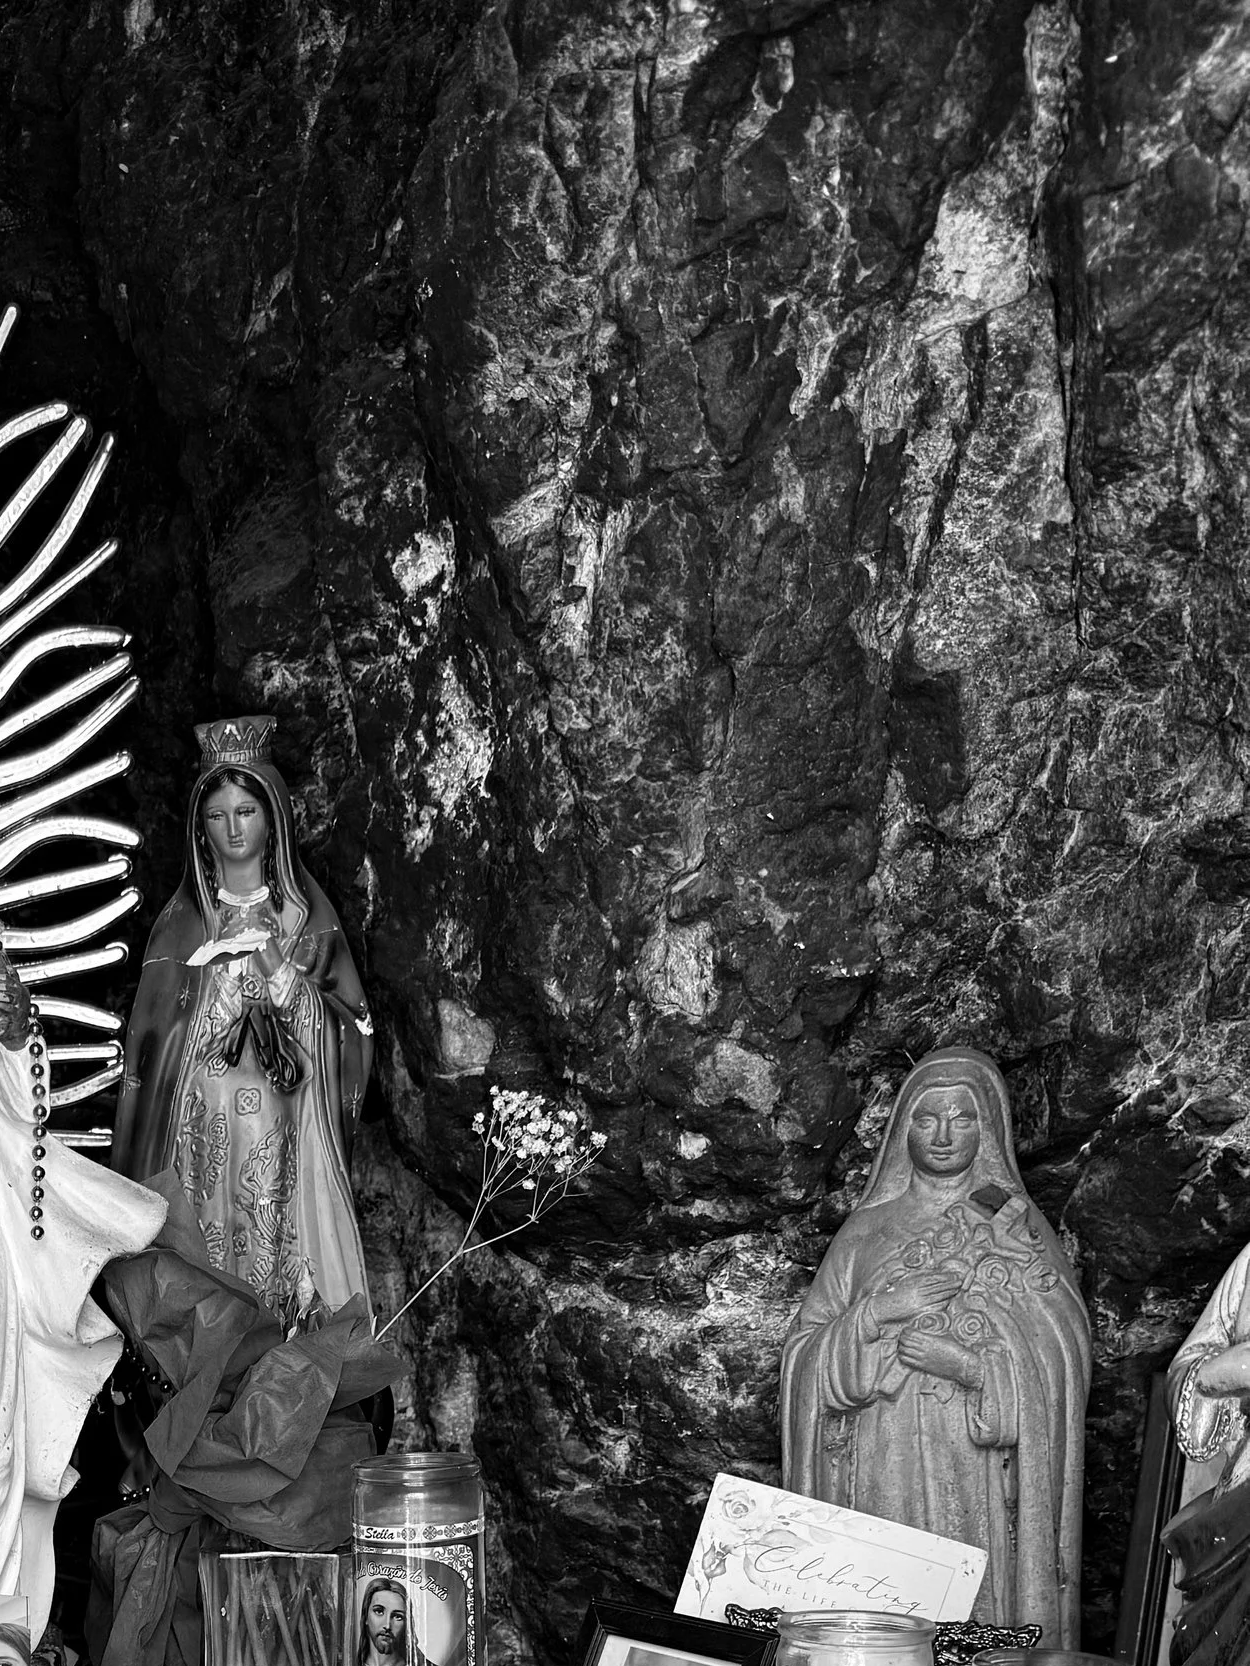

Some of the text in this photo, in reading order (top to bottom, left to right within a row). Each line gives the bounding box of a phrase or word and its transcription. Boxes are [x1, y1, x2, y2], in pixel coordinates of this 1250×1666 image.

[365, 1527, 395, 1541] Stella
[367, 1561, 407, 1580] Corazón
[409, 1569, 423, 1585] de
[420, 1576, 449, 1601] Jesús
[754, 1545, 927, 1614] Celebrating
[763, 1579, 838, 1609] THE LIFE
